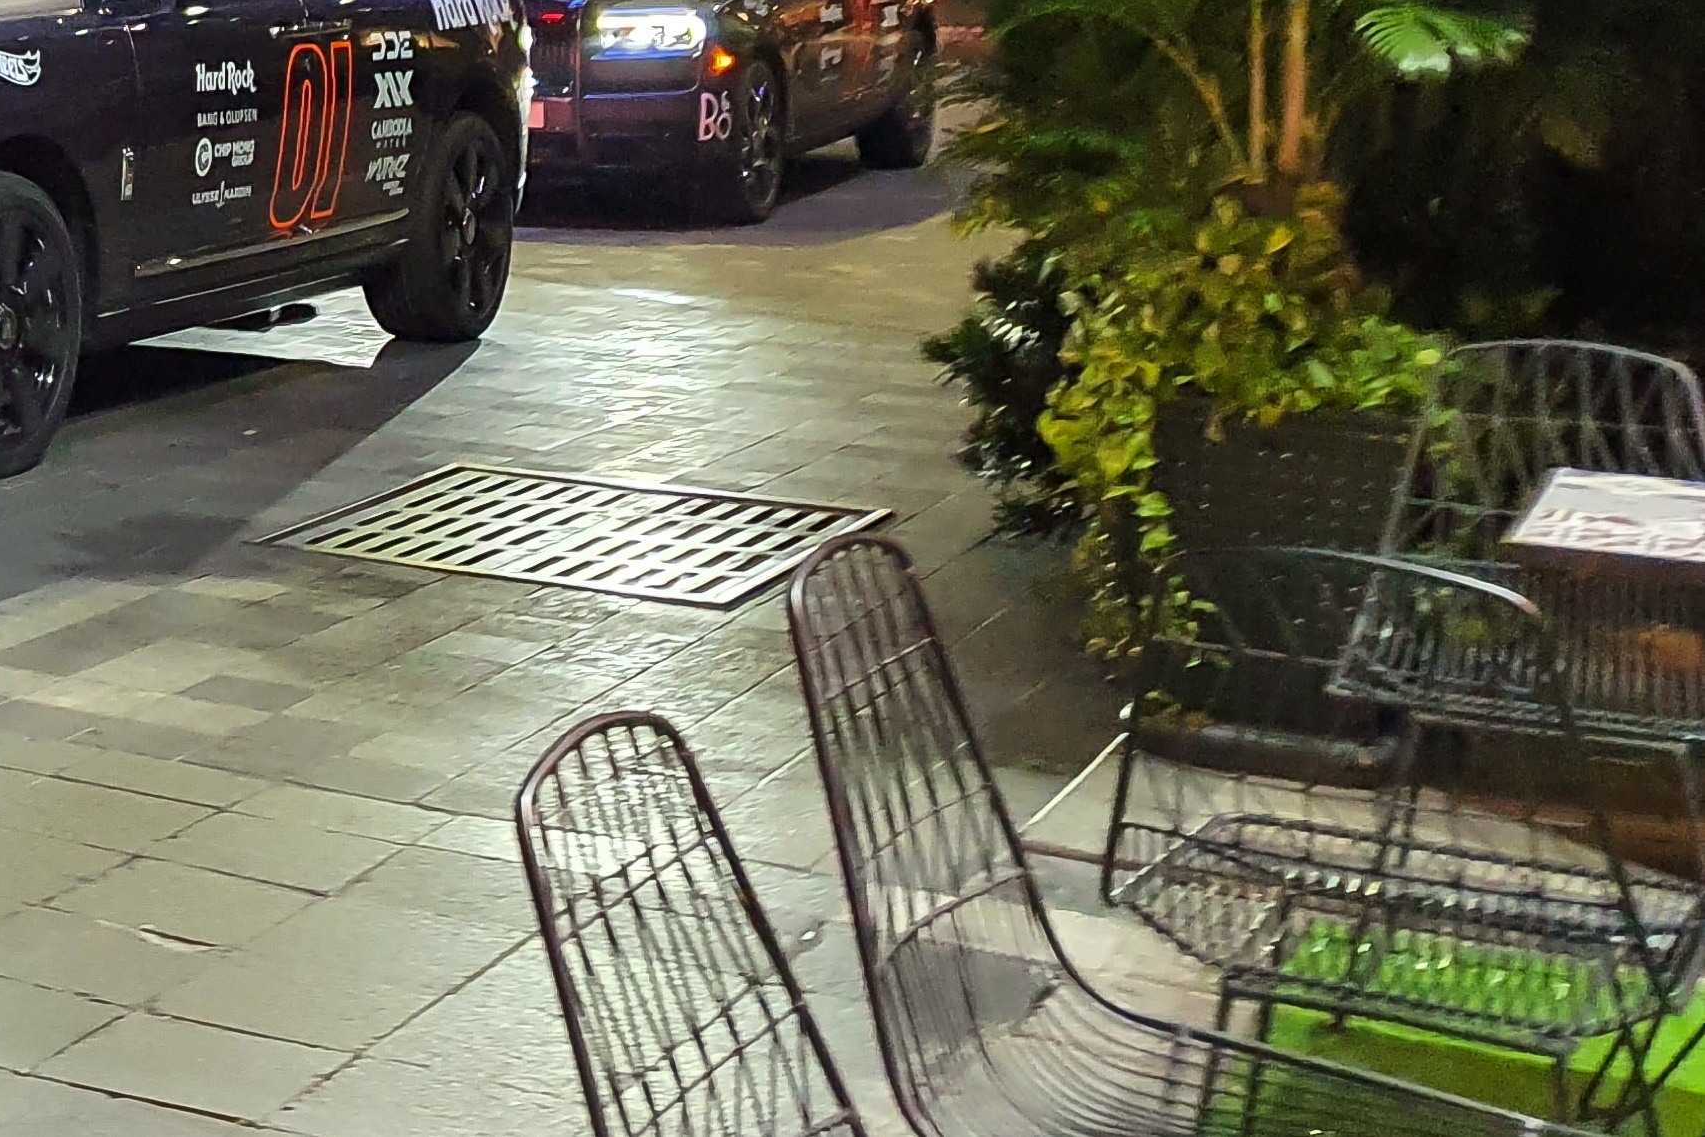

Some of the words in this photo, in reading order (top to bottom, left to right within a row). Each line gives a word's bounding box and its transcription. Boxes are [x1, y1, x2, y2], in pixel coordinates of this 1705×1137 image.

[196, 62, 225, 92] Hard
[227, 60, 257, 95] Rock
[269, 41, 352, 228] 01
